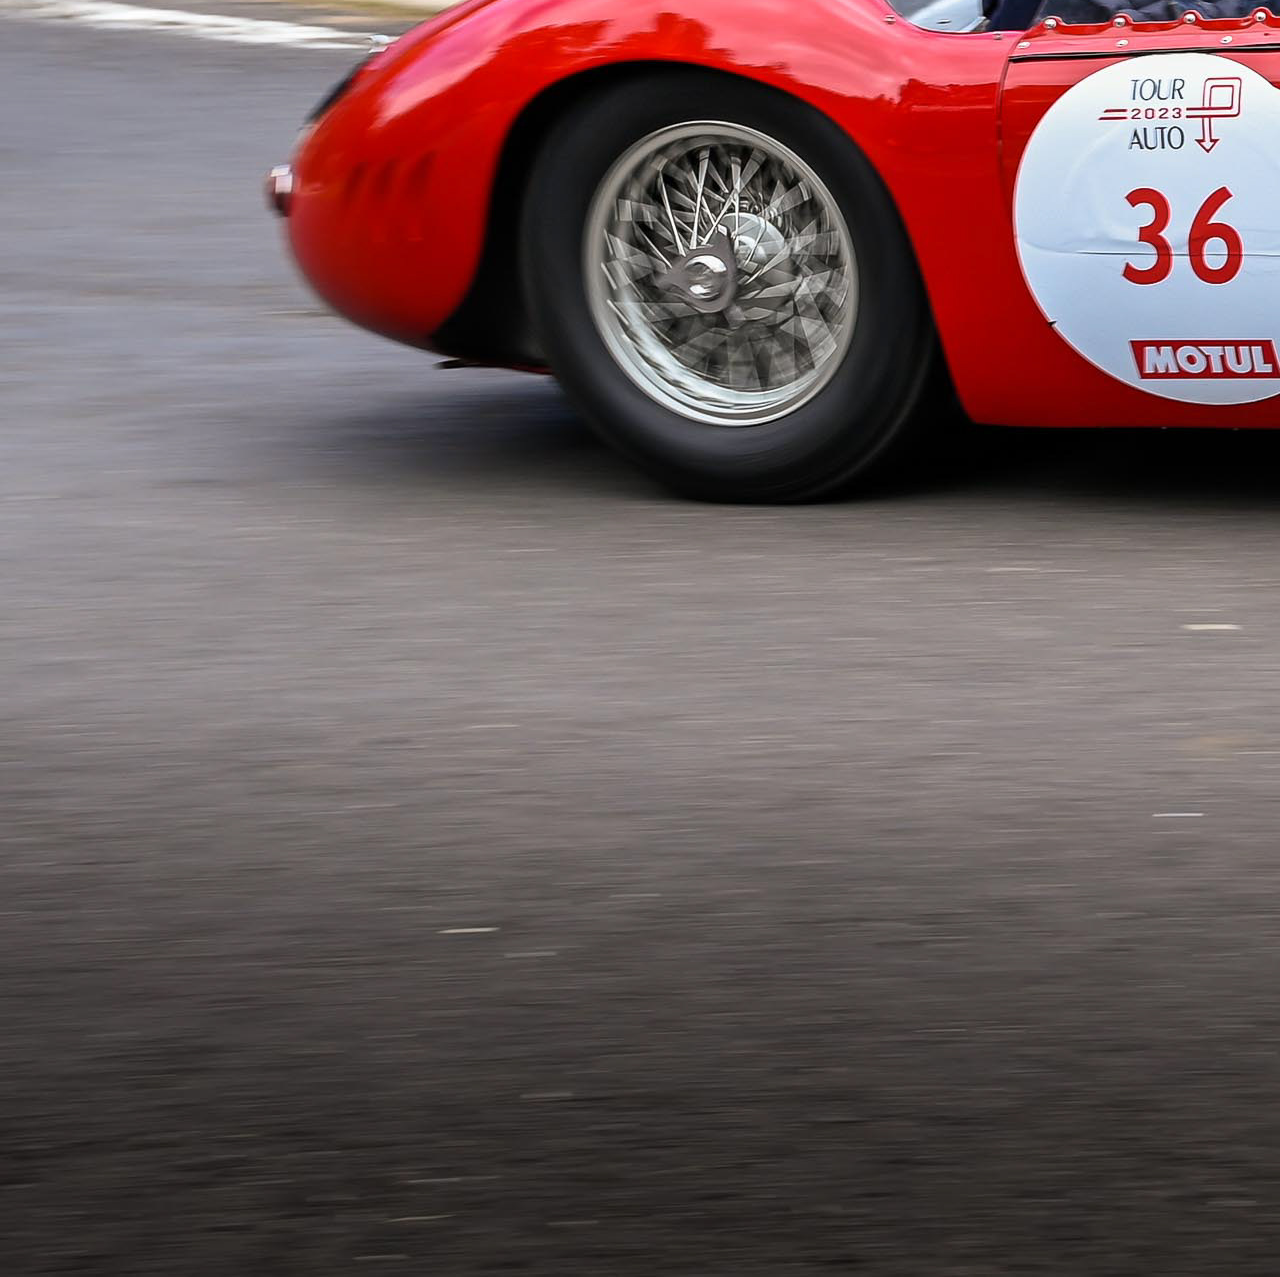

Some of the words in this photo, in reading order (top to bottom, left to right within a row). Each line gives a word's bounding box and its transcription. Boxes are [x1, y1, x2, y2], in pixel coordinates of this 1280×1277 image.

[1130, 78, 1185, 101] TOUR
[1131, 108, 1182, 120] 2023
[1128, 125, 1185, 150] AUTO
[1122, 186, 1244, 285] 36
[1143, 345, 1273, 373] MOTUL
